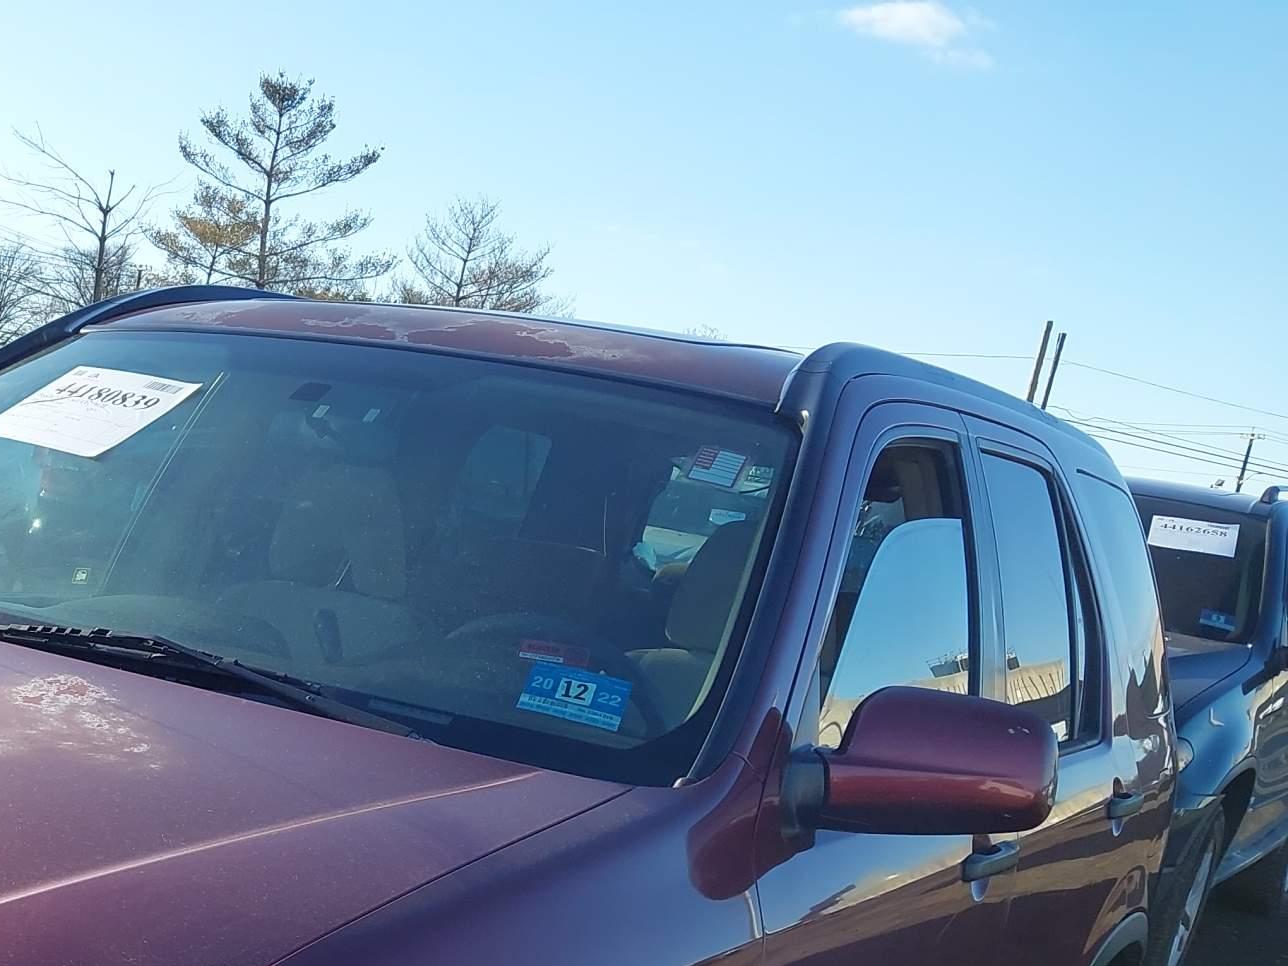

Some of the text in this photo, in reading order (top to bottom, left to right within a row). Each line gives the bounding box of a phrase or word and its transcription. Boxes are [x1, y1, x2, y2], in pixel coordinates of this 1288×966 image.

[55, 382, 161, 410] 44180839
[531, 675, 623, 708] 20 12 22
